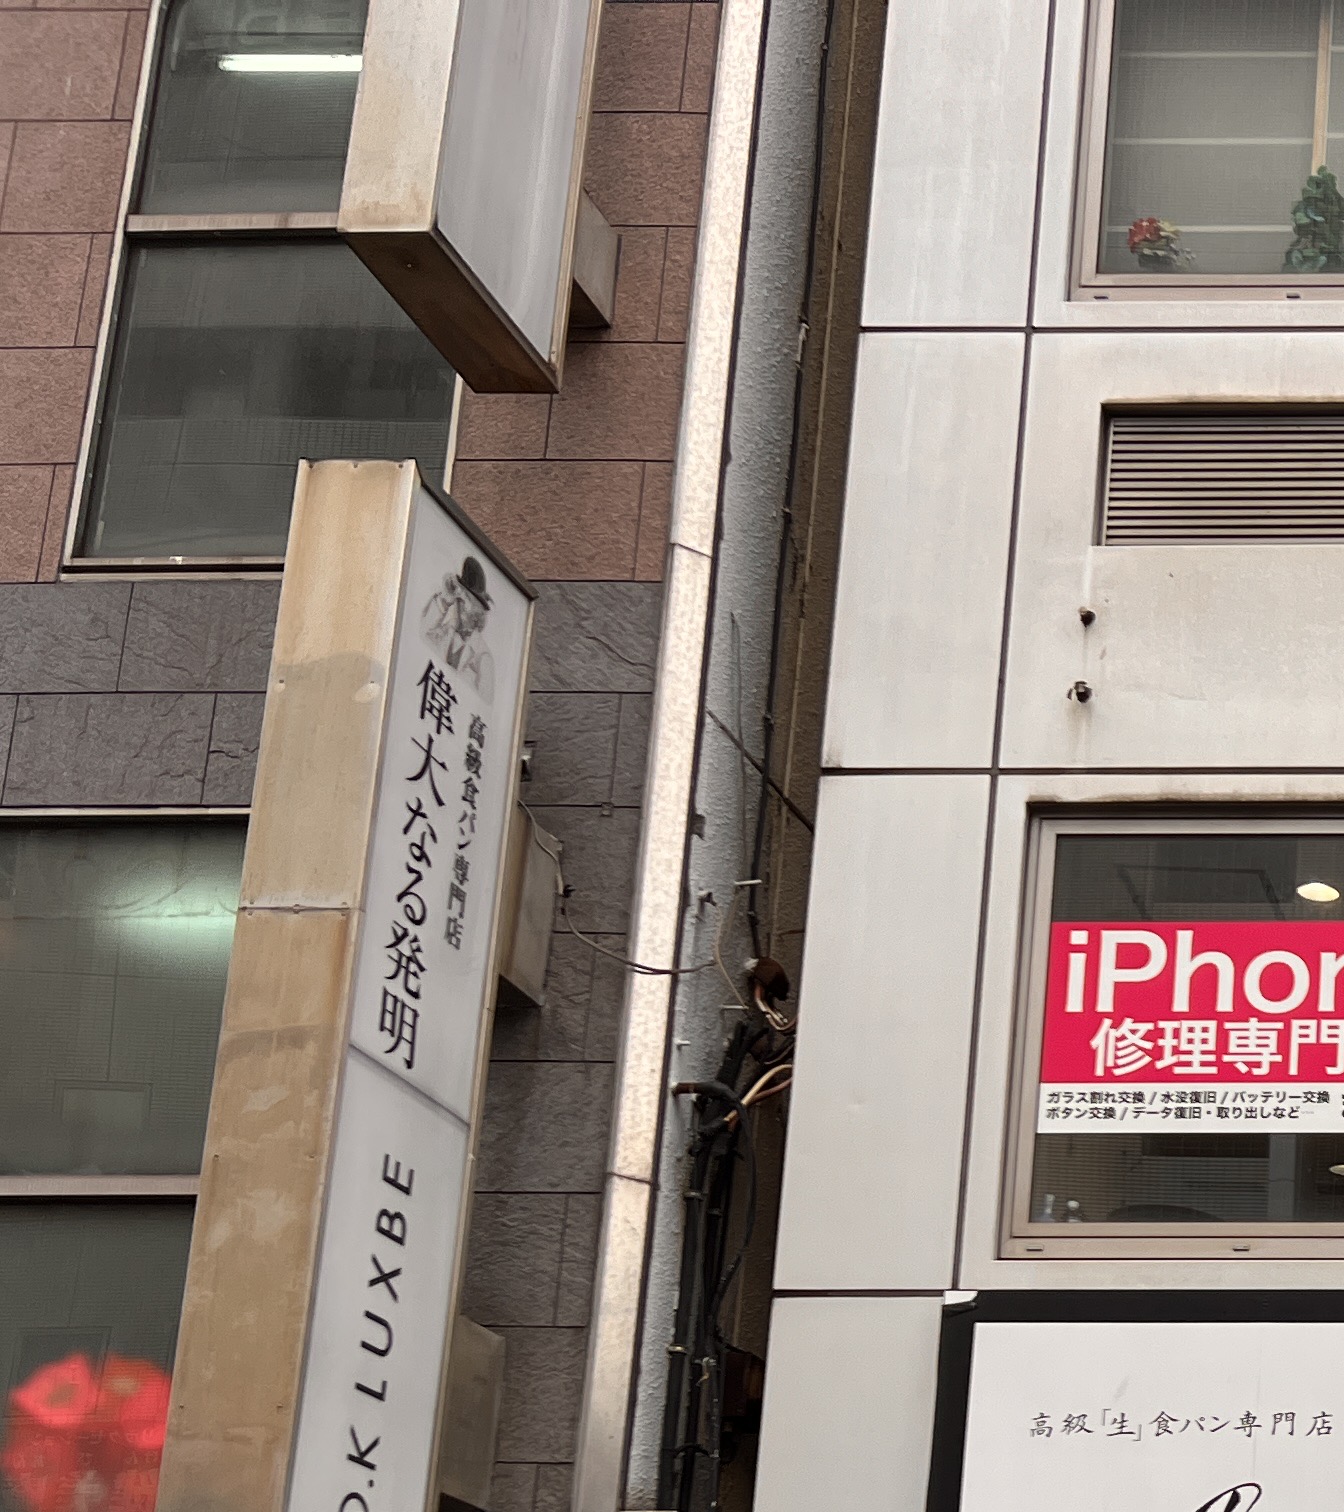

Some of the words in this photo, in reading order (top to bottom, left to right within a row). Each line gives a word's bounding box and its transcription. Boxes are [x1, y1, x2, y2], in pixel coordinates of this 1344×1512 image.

[379, 658, 459, 1073] 偉大なる発明
[444, 713, 487, 951] 高級食パン専門店
[356, 1158, 416, 1402] LUXBE
[1029, 1408, 1335, 1441] 高級「生」食パン専門店
